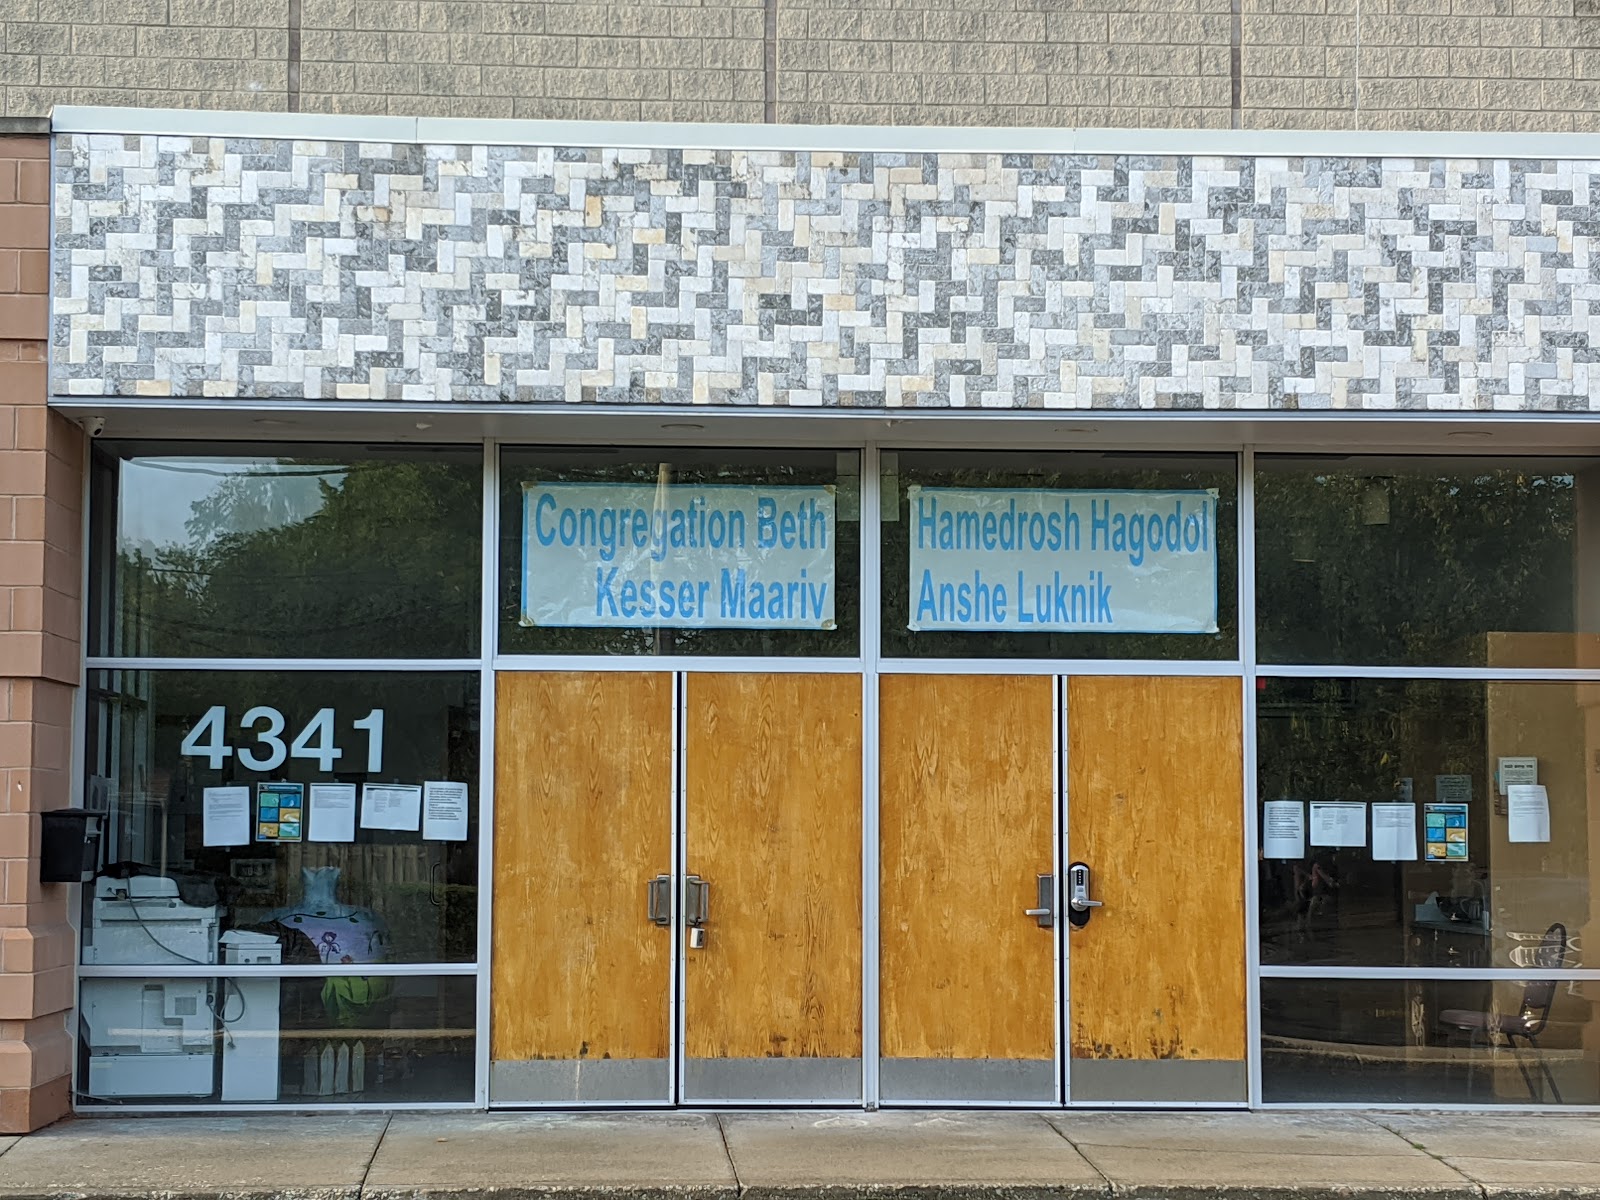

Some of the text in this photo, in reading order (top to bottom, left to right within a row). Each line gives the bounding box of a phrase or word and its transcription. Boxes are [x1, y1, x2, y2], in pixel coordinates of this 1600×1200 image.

[535, 493, 827, 562] Congregation Beth
[918, 497, 1208, 567] Hamedrosh Hagodol
[596, 567, 827, 620] Kesser Maariv
[916, 569, 1114, 624] Anshe Luknik
[180, 705, 384, 773] 4341
